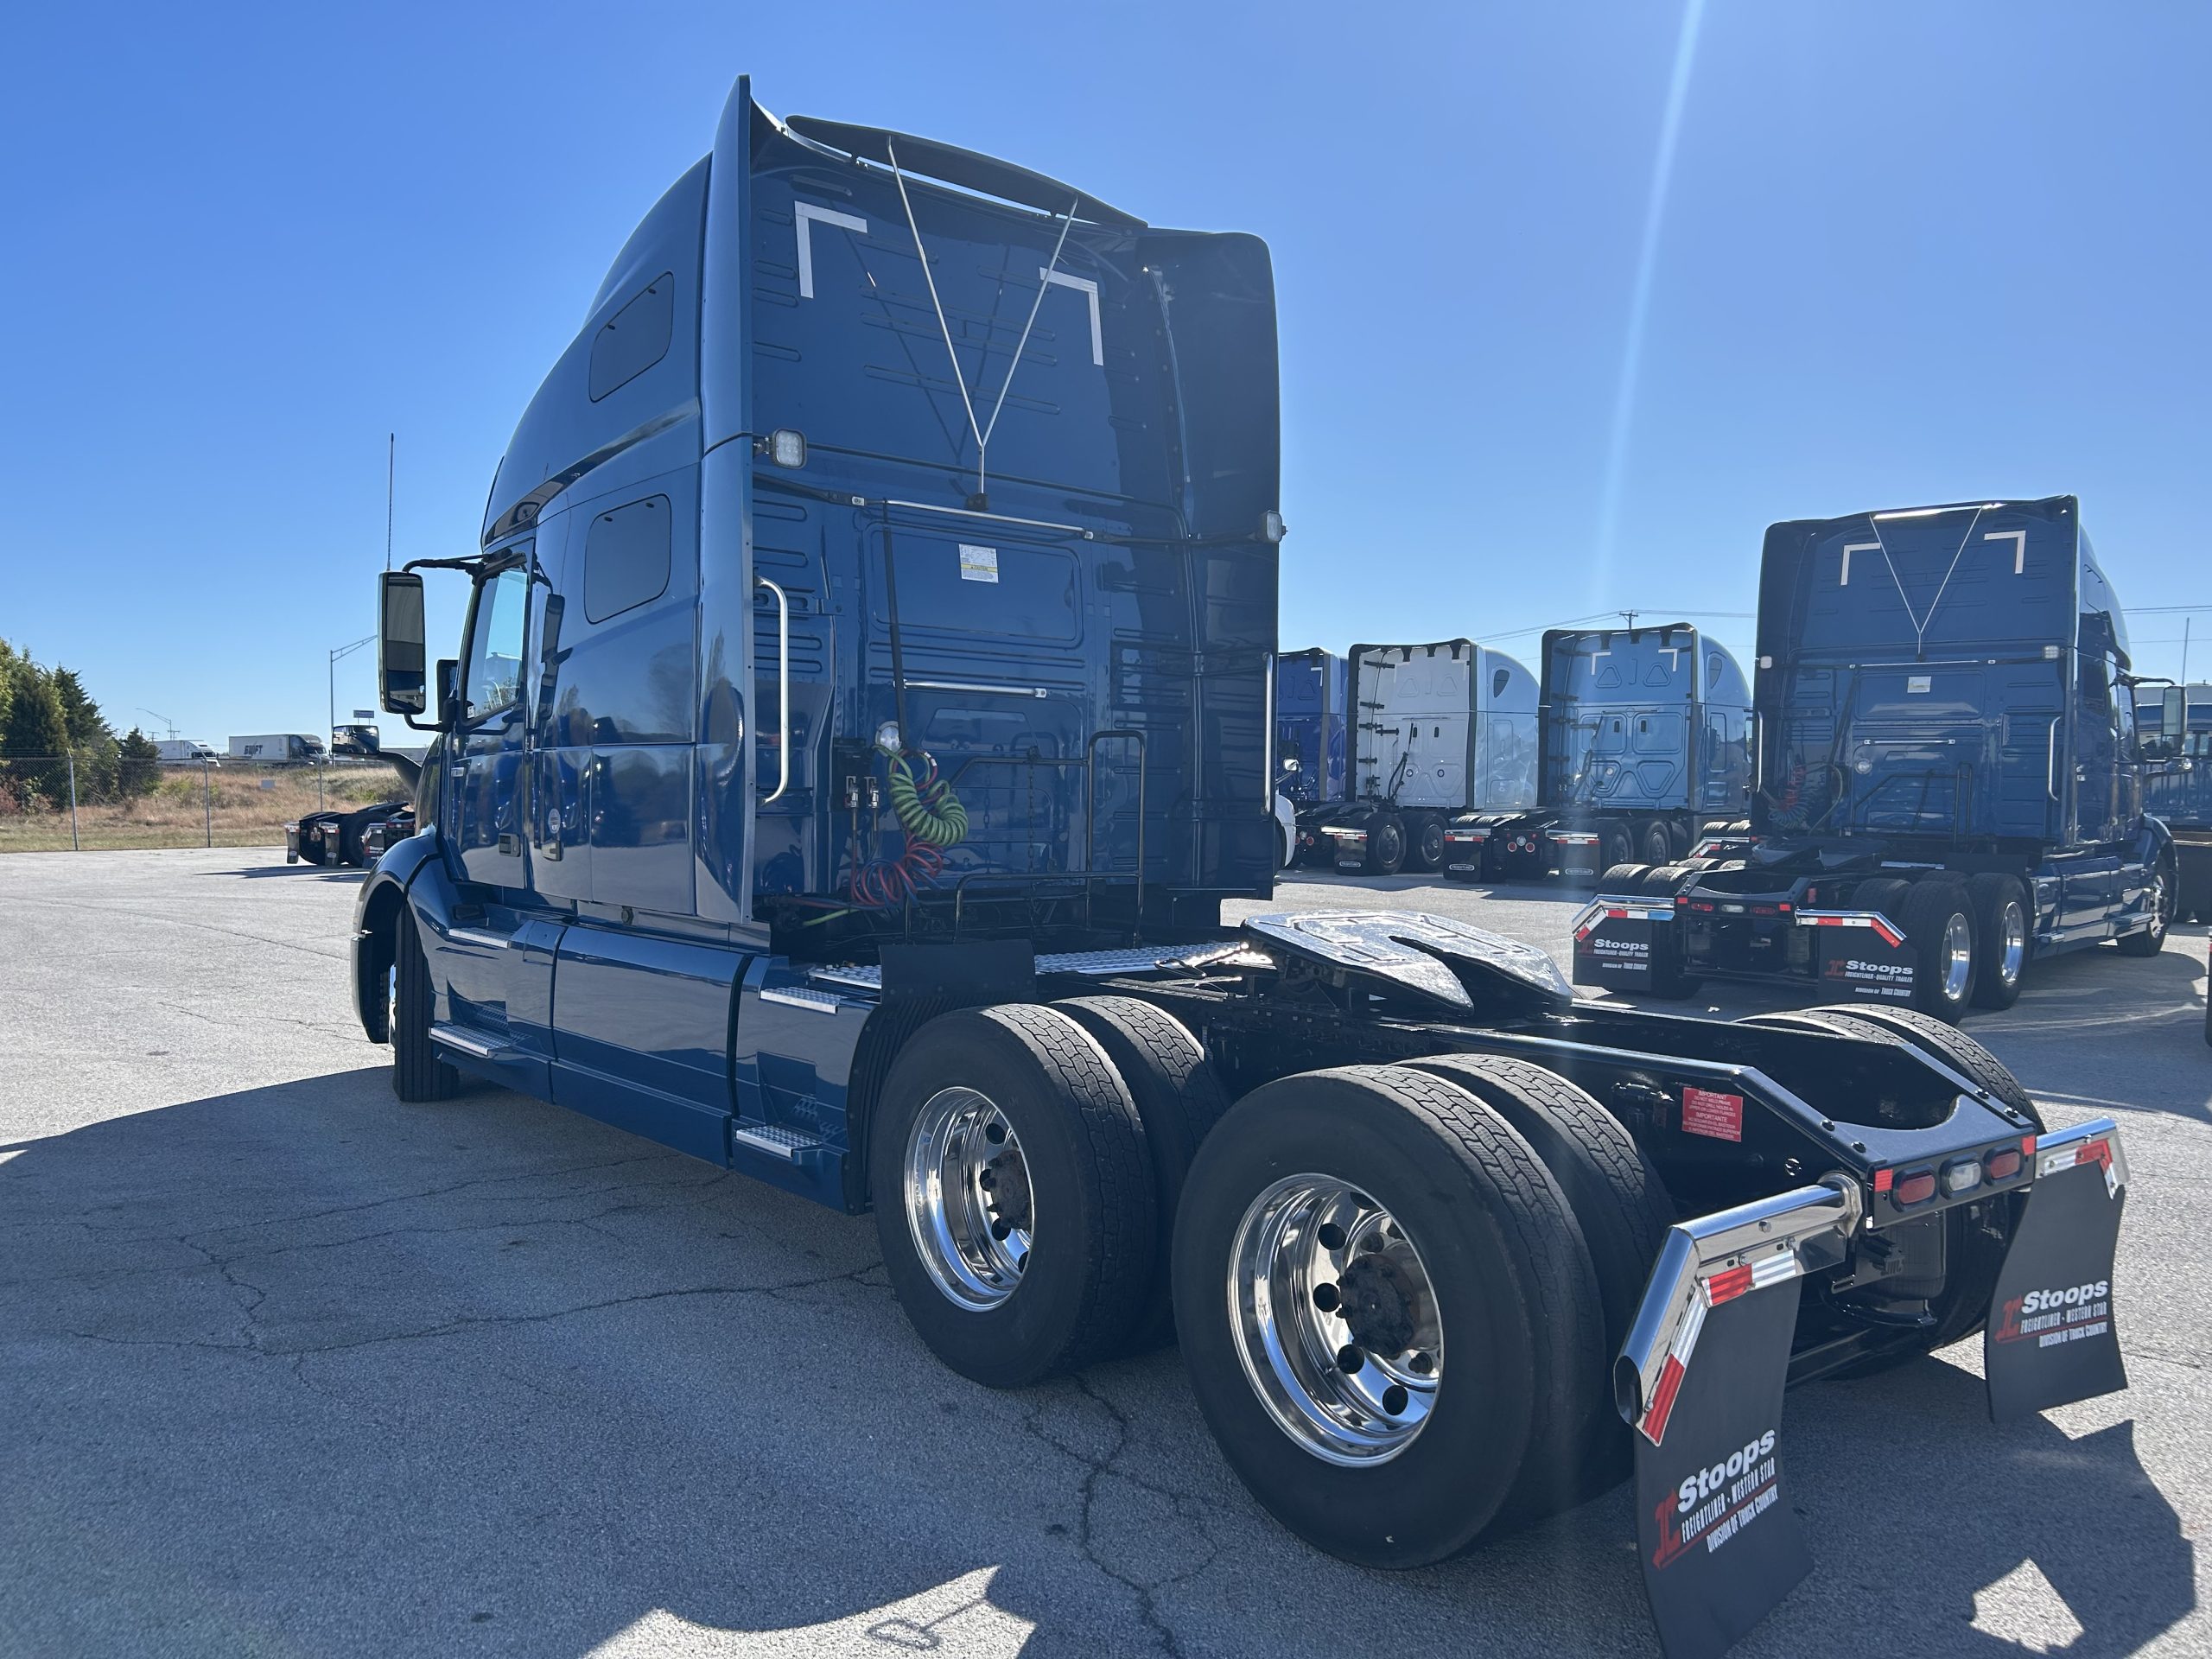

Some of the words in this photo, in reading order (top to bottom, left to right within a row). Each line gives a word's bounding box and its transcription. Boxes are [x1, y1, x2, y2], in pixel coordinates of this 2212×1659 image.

[1594, 938, 1649, 950] Stoops
[1846, 960, 1914, 975] Stoops
[1698, 1090, 1726, 1100] IMPORTANT
[1696, 1111, 1728, 1122] IMPORTANTE
[2022, 1280, 2108, 1314] Stoops
[1677, 1429, 1776, 1512] Stoops
[1681, 1493, 1726, 1543] FREIGHTLINER
[1731, 1468, 1759, 1504] WESTERN
[1760, 1457, 1776, 1484] STAR
[1707, 1519, 1732, 1553] DIVISION
[1730, 1514, 1738, 1534] OF
[1737, 1501, 1757, 1528] TRUCK
[1755, 1484, 1778, 1514] COUNTRY
